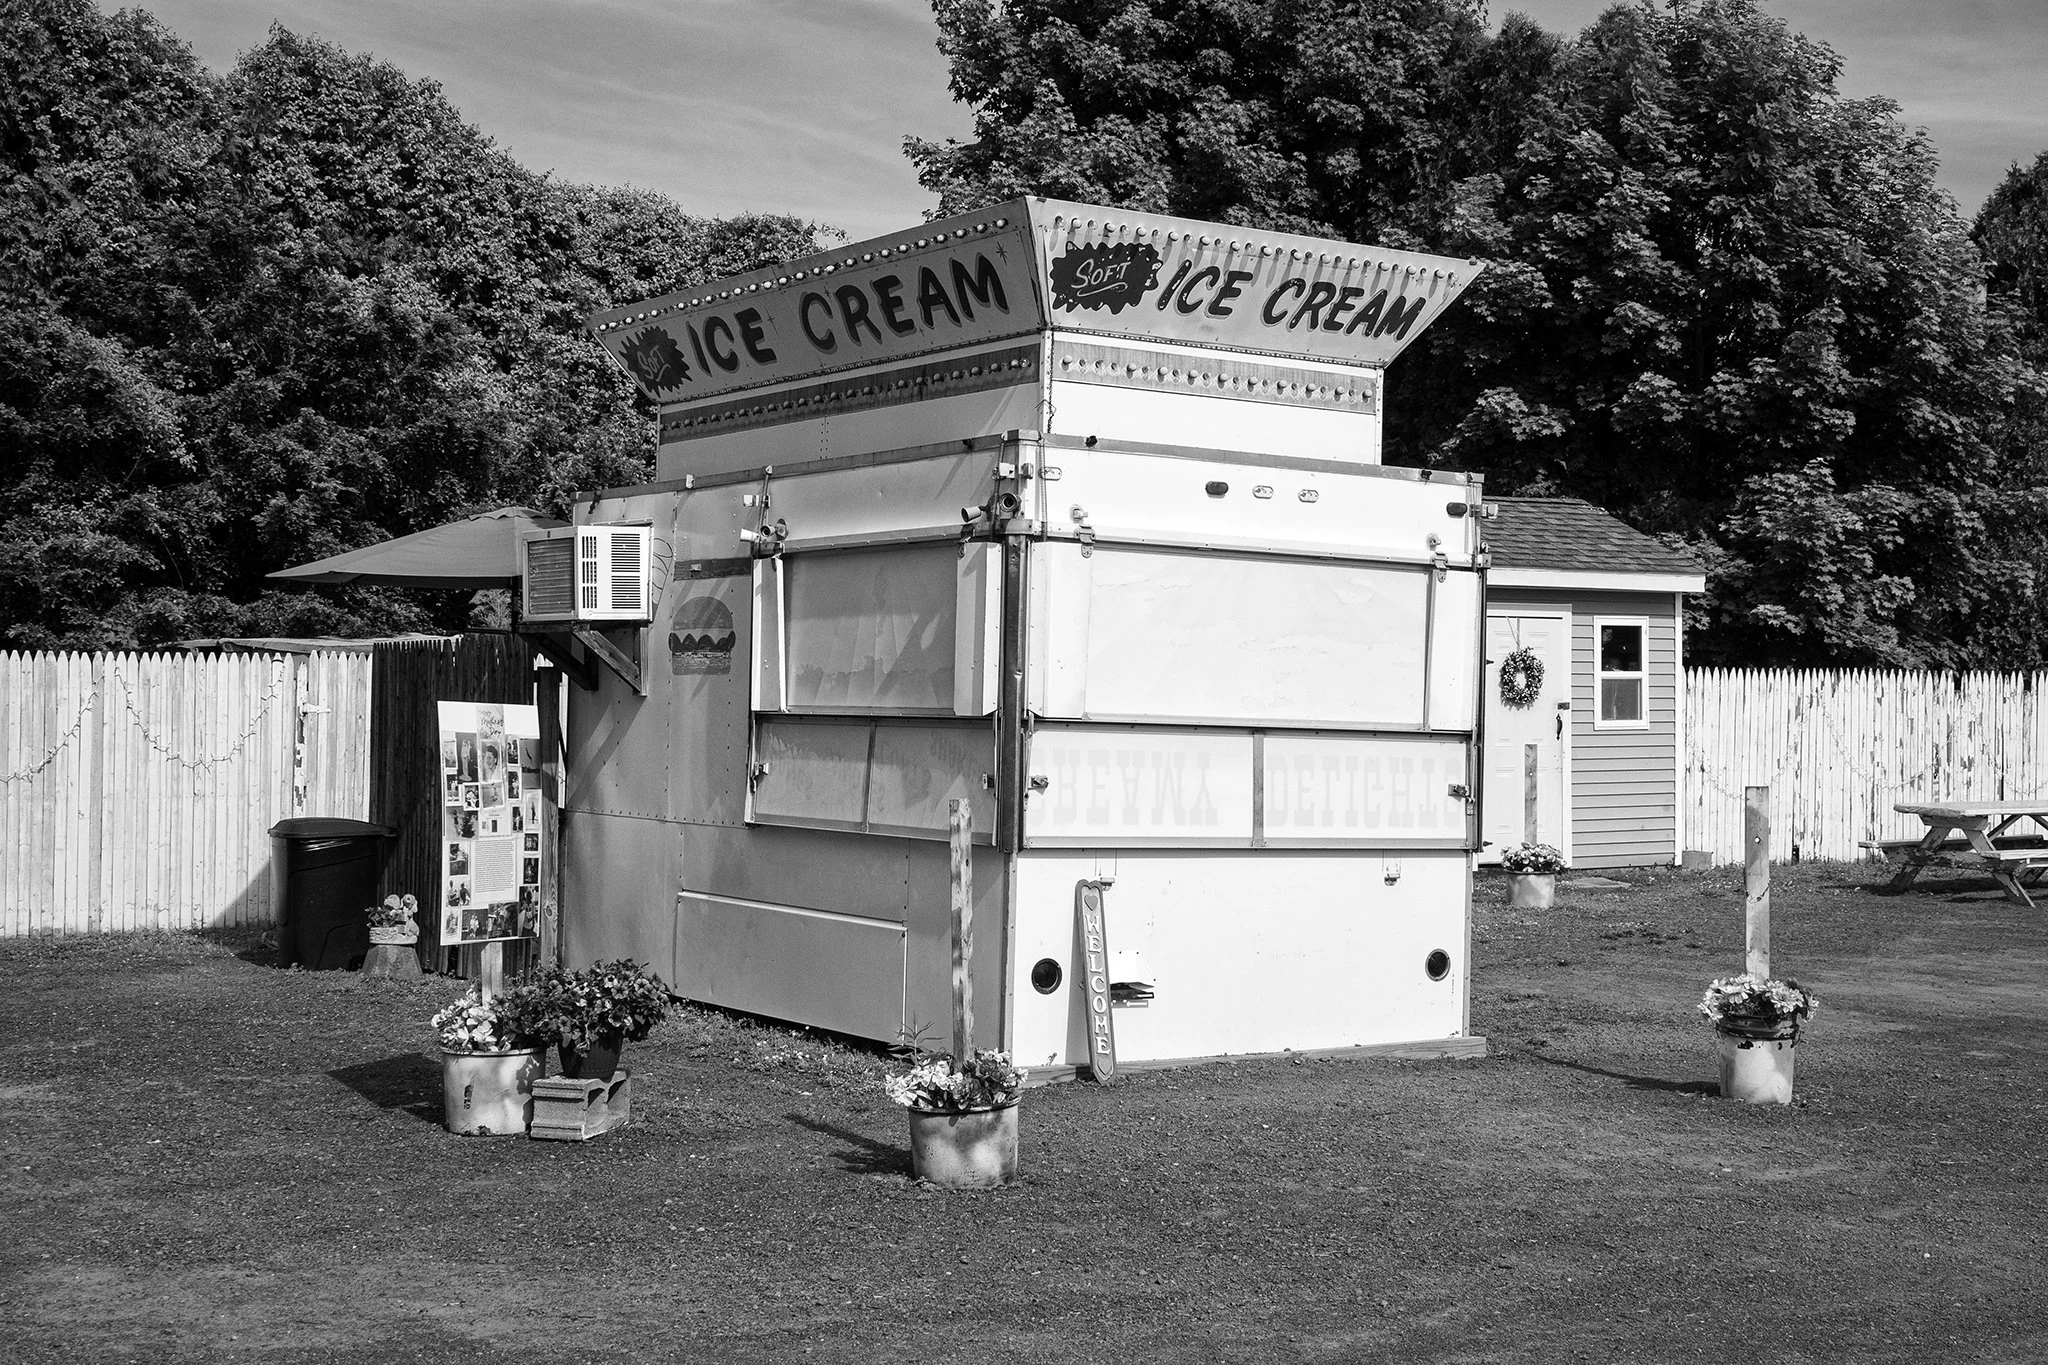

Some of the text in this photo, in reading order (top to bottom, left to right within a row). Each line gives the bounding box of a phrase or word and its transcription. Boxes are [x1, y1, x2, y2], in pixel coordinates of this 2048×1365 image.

[686, 252, 1009, 377] ICE CREAM
[1071, 258, 1131, 288] SOFT
[1156, 259, 1427, 342] ICE CREAM
[637, 345, 666, 380] SOFT
[1084, 914, 1111, 1055] WELCOME
